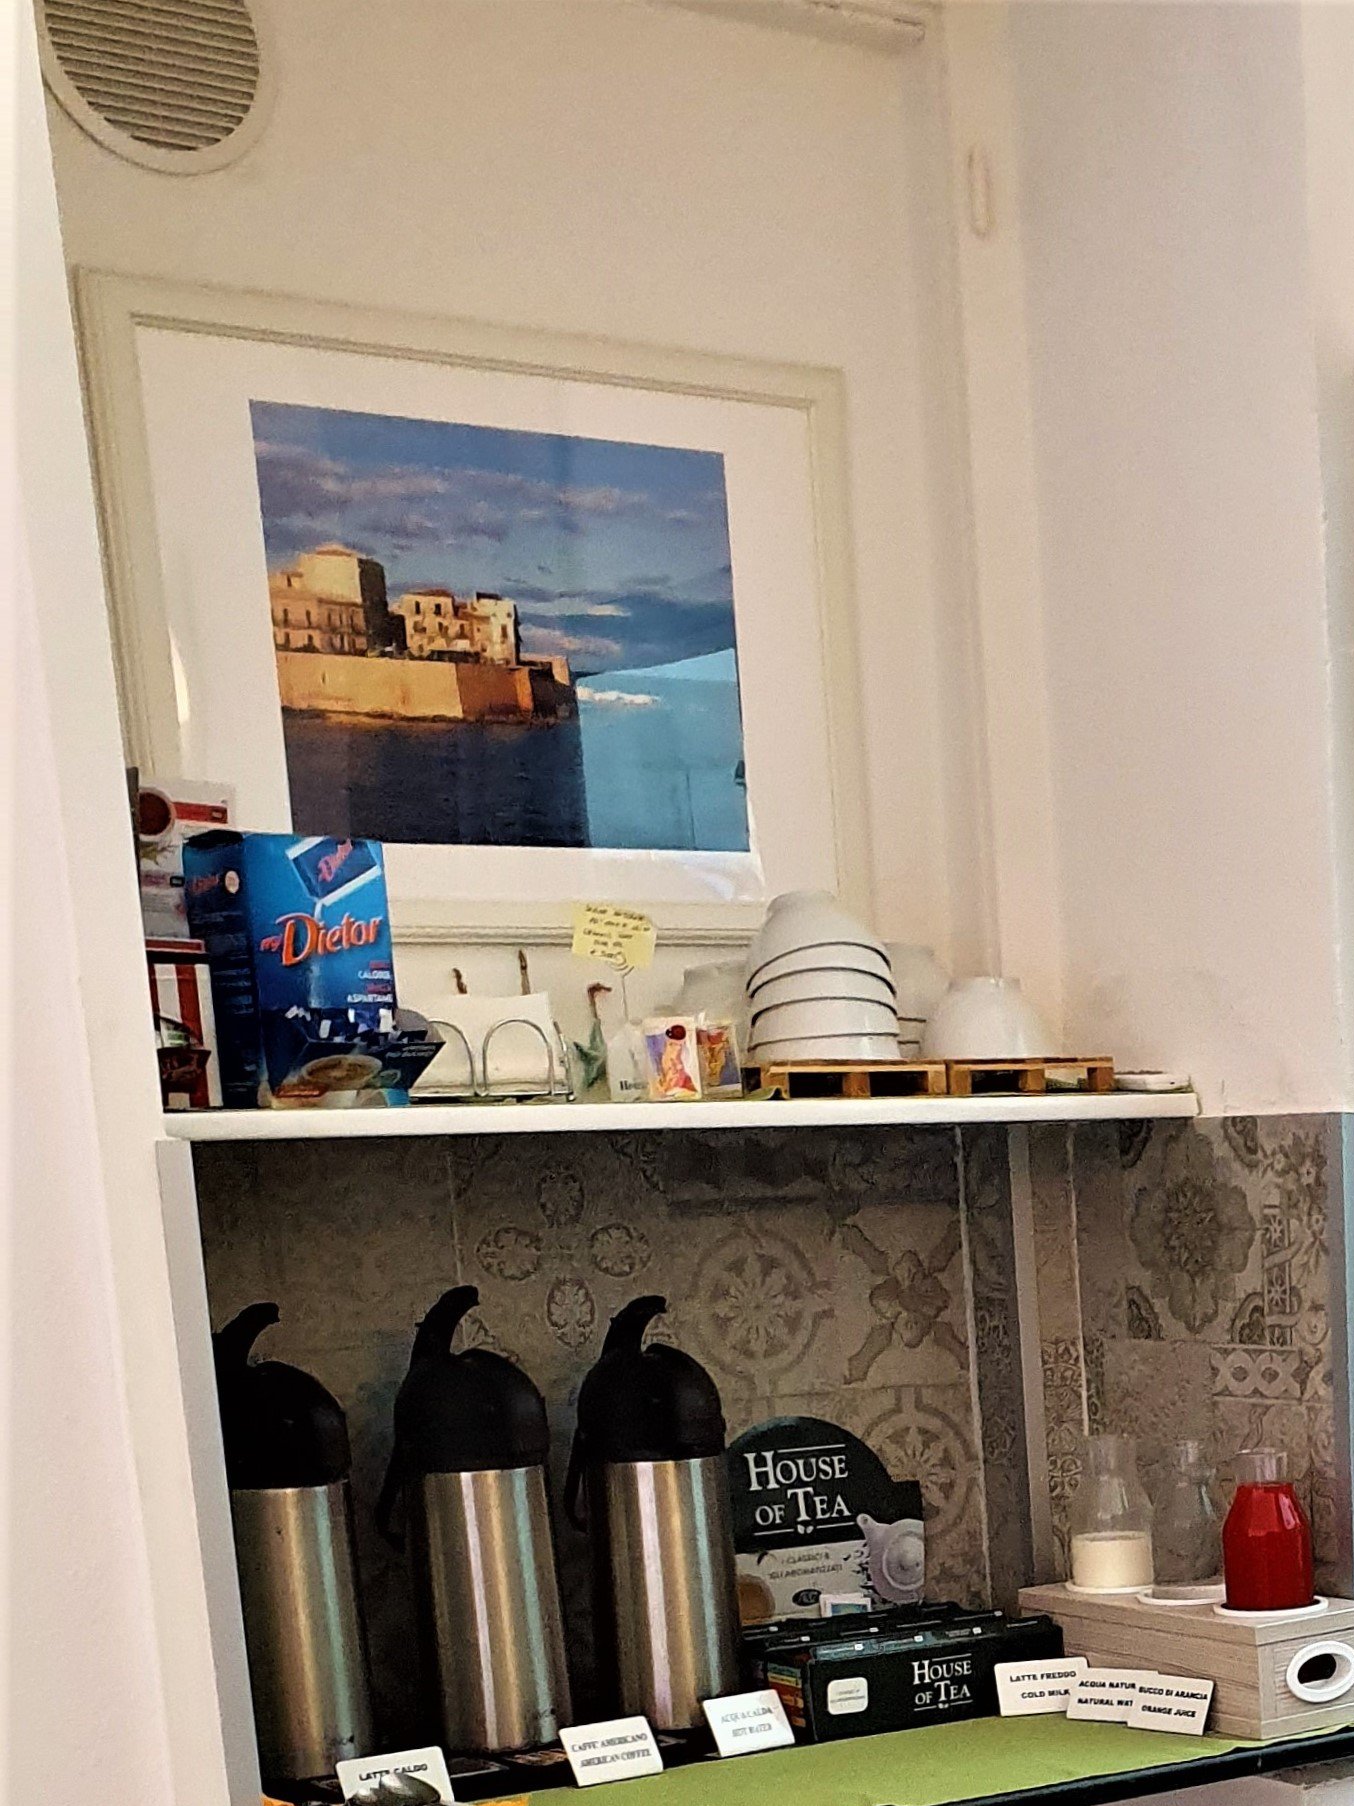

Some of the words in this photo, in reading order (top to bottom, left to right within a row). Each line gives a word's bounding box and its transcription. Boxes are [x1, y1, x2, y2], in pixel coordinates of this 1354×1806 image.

[275, 911, 383, 967] Dietor
[1009, 1672, 1038, 1682] LATTE
[1040, 1670, 1077, 1680] FREDDO
[1078, 1680, 1106, 1688] ACQUA
[1021, 1690, 1046, 1699] COLD
[1077, 1698, 1114, 1706] NATURAL
[1141, 1704, 1173, 1715] ORANGE
[1174, 1708, 1197, 1718] JUICE
[600, 1732, 648, 1748] AMERICANO
[581, 1754, 621, 1767] AMERICAN
[621, 1748, 652, 1761] COFFEE
